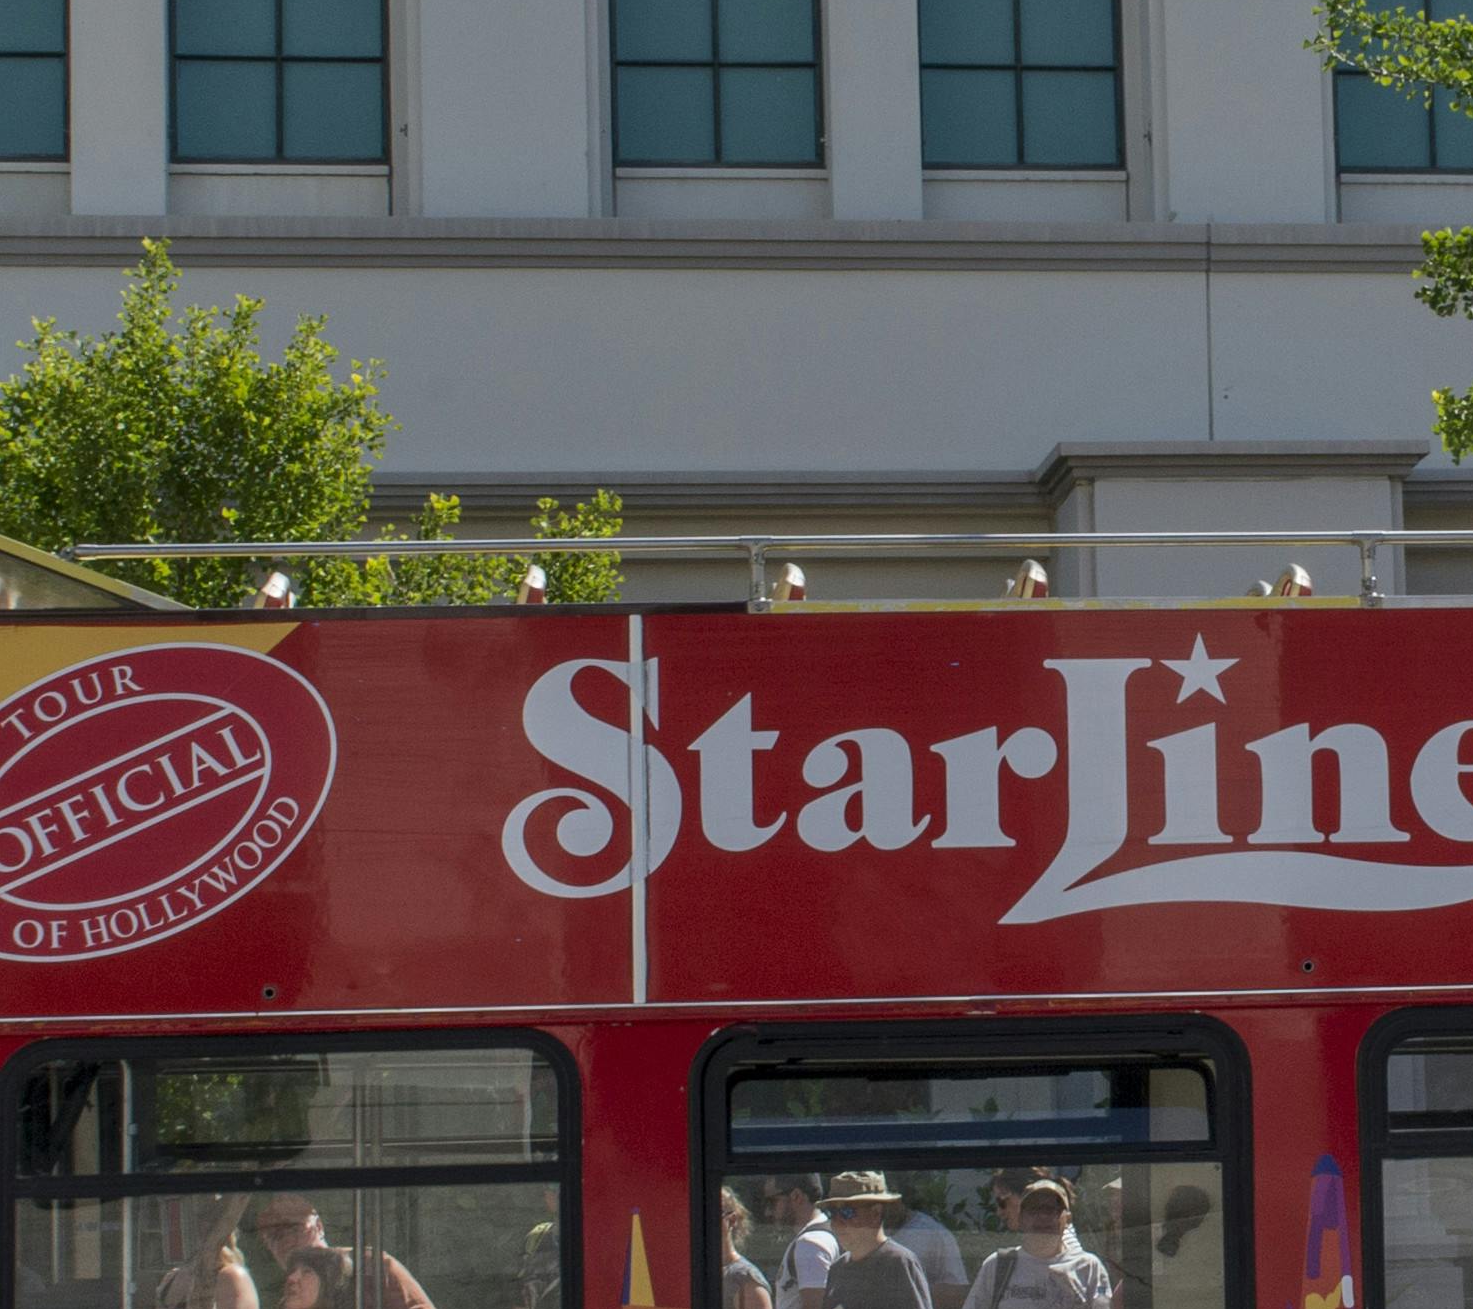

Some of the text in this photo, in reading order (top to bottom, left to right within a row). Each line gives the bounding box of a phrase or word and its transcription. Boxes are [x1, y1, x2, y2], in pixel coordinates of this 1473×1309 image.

[0, 664, 144, 741] TOUR
[13, 795, 299, 950] OF HOLLYWOOD
